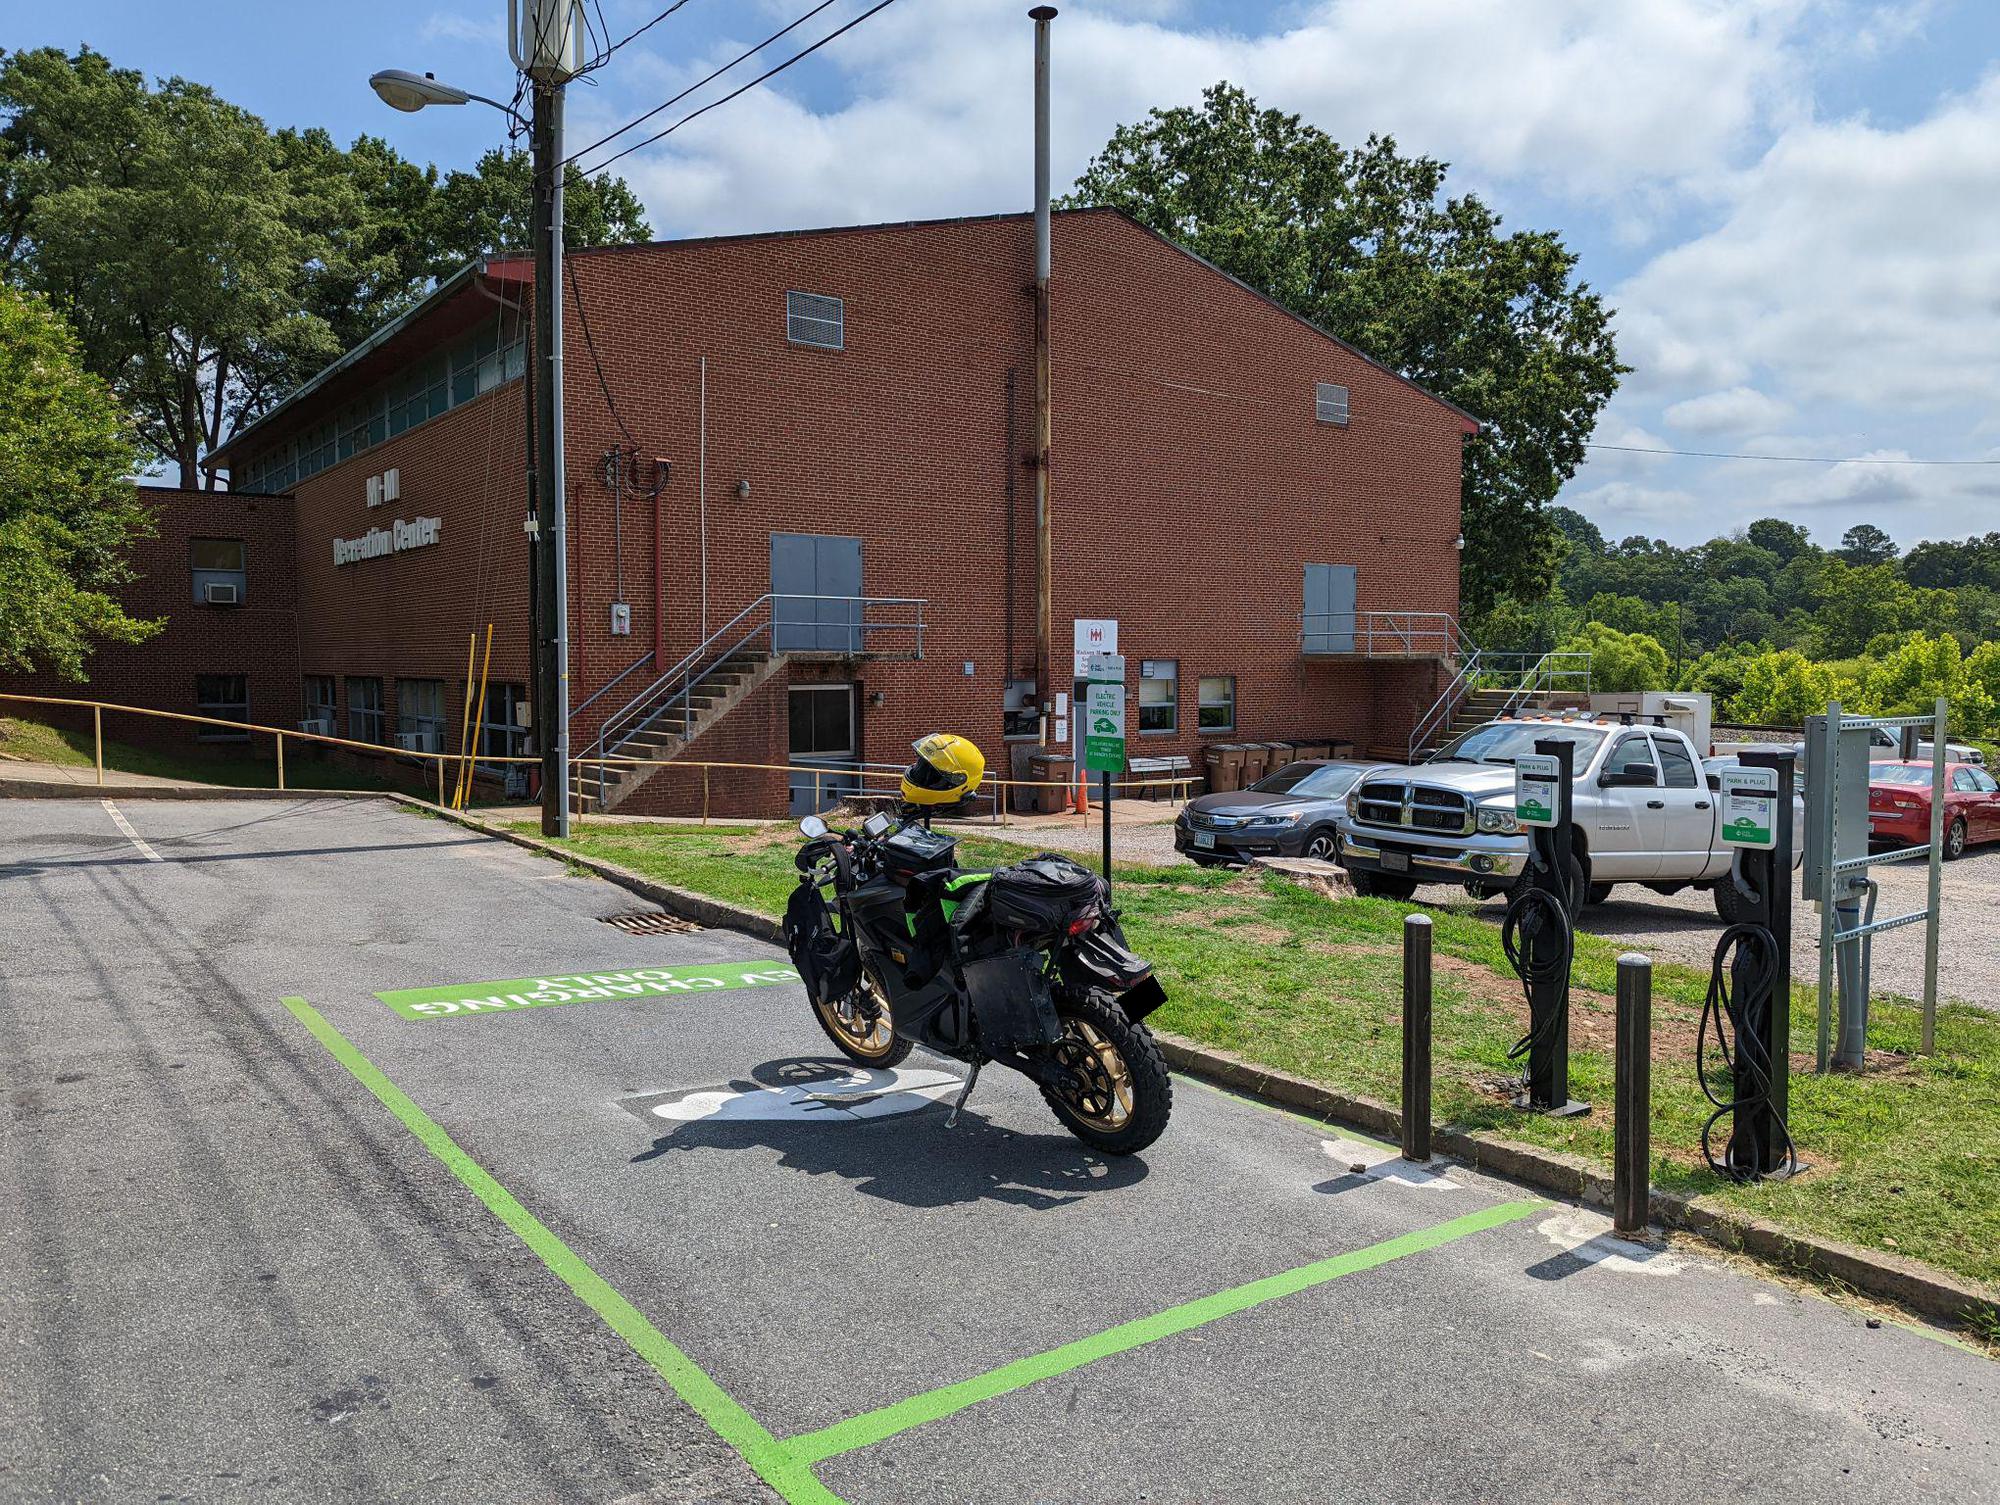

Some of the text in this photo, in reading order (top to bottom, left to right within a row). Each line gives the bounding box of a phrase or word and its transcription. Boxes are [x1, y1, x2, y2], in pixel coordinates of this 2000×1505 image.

[333, 516, 442, 566] Recreation Center
[409, 969, 801, 1014] EV CHARGING
[534, 970, 673, 990] ONLY
